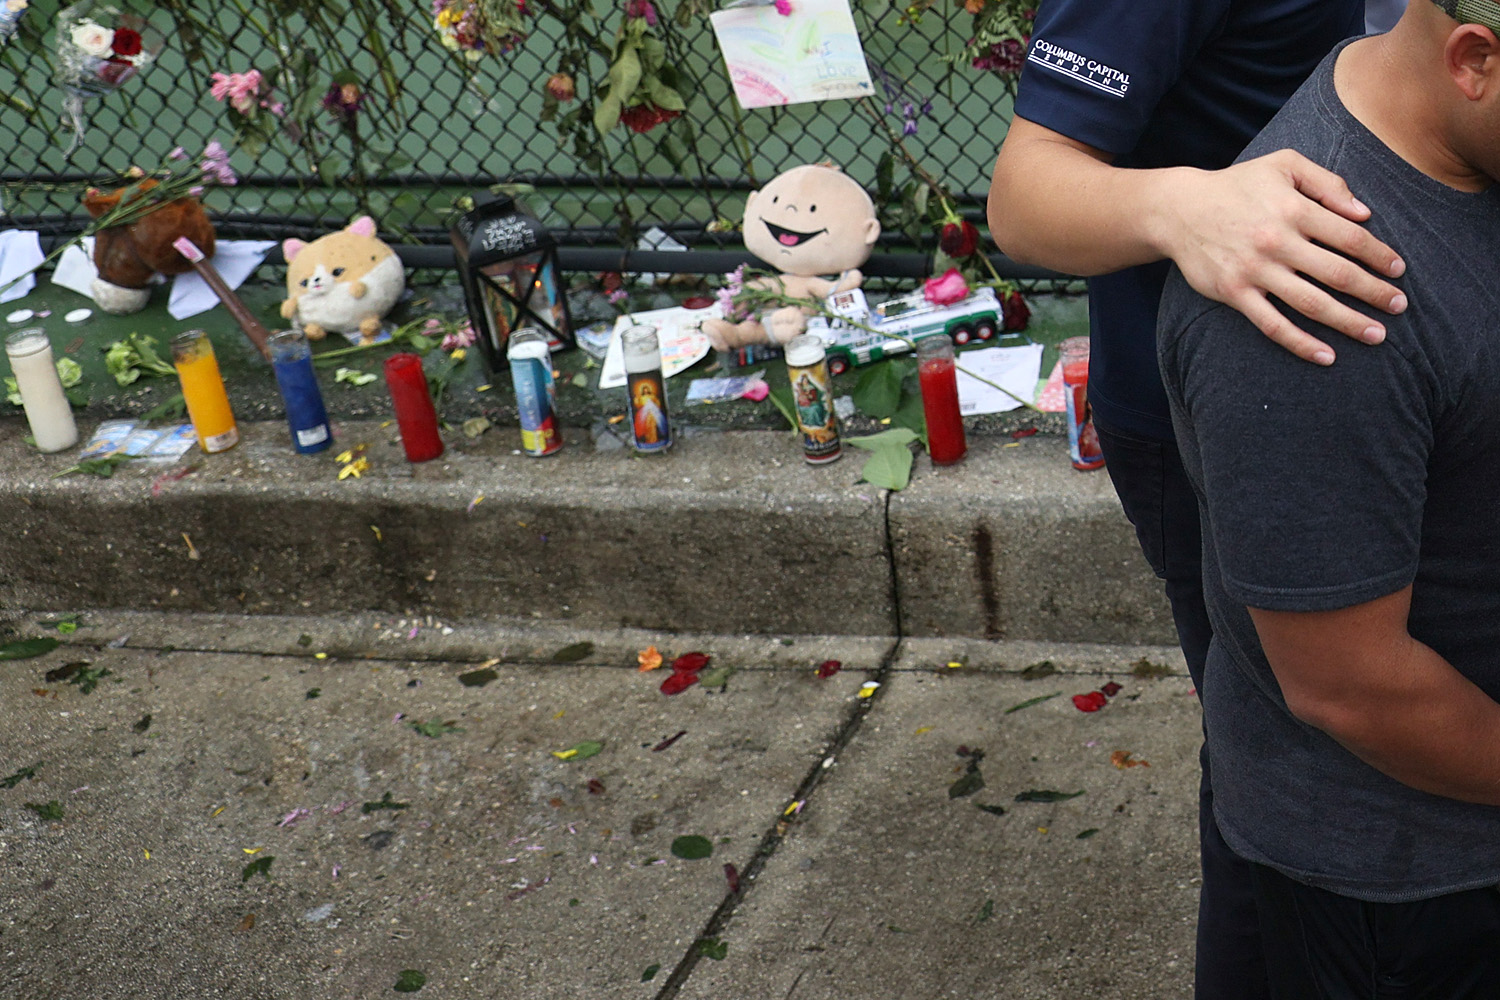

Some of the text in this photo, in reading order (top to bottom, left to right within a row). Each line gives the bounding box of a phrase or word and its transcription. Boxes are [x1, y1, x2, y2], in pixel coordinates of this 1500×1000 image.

[1030, 47, 1129, 92] LENDING
[1035, 39, 1130, 85] COLUMBUS CAPITAL
